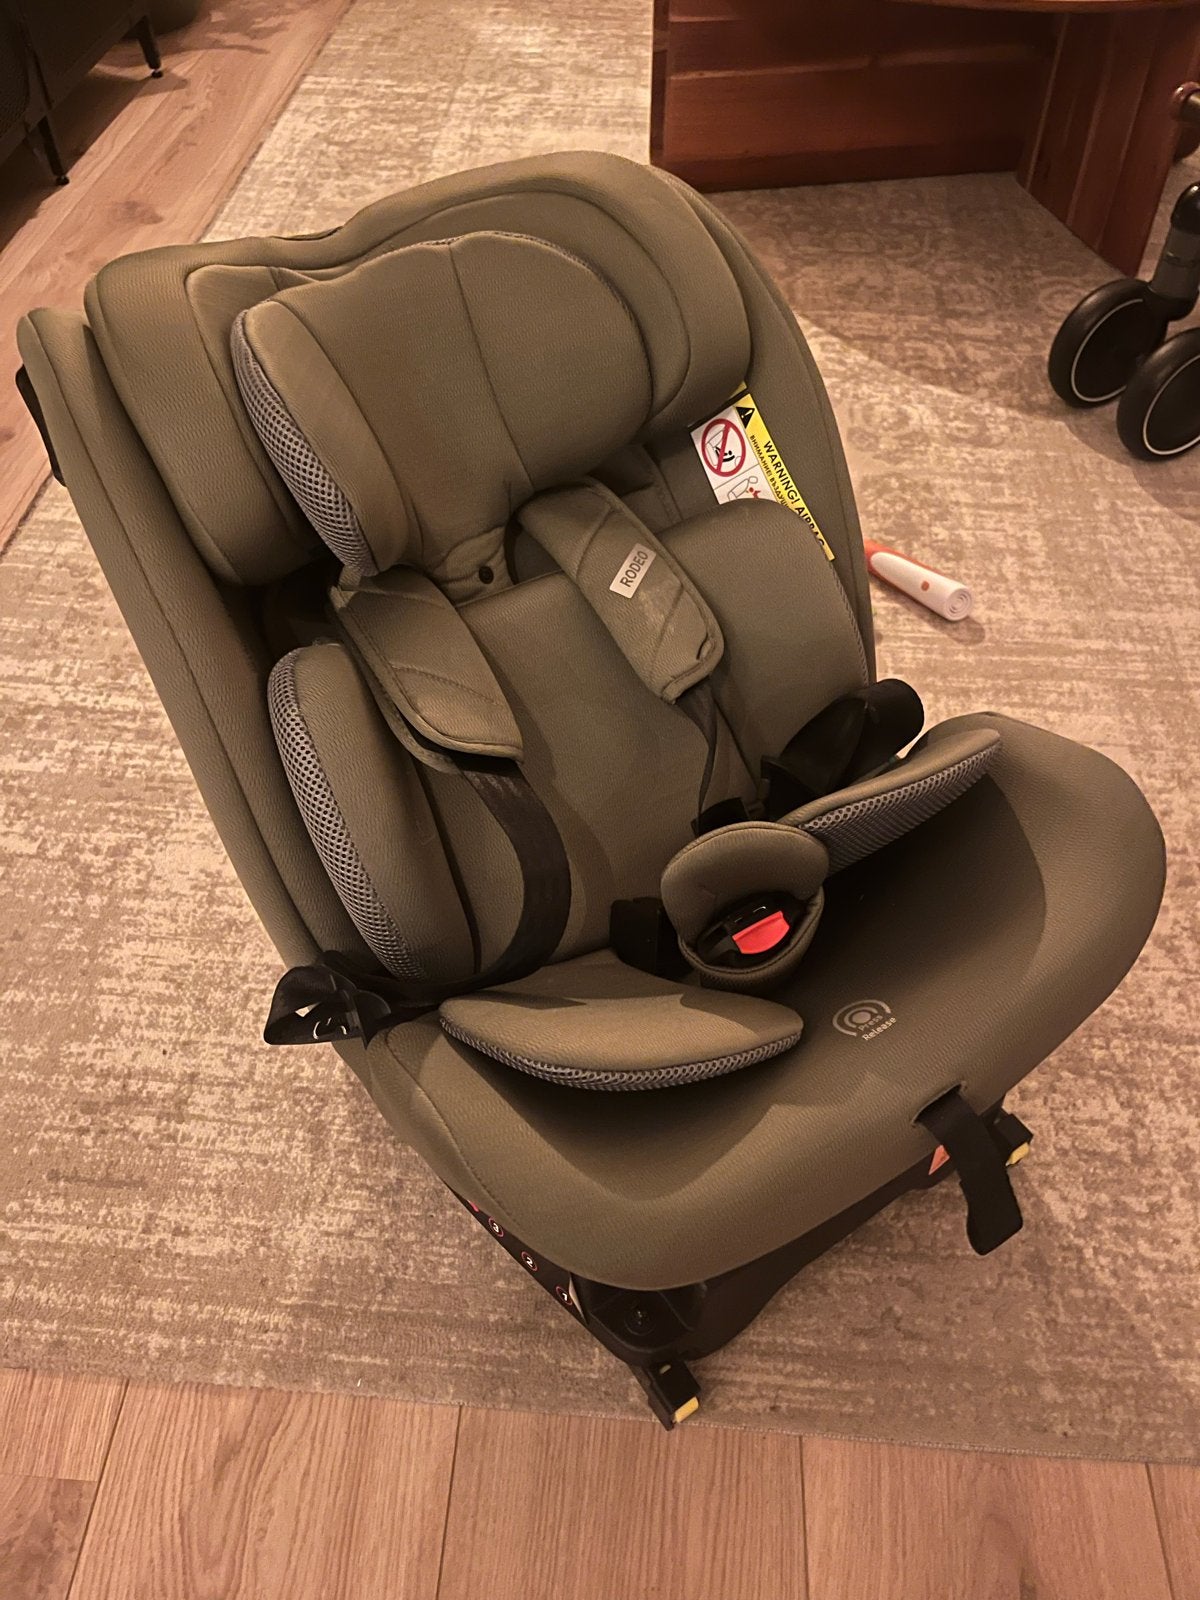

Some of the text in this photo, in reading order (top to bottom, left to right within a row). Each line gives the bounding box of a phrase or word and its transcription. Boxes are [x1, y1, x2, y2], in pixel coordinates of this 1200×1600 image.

[763, 440, 801, 505] WARNING!
[619, 550, 649, 588] RODEO
[861, 1017, 897, 1041] Release
